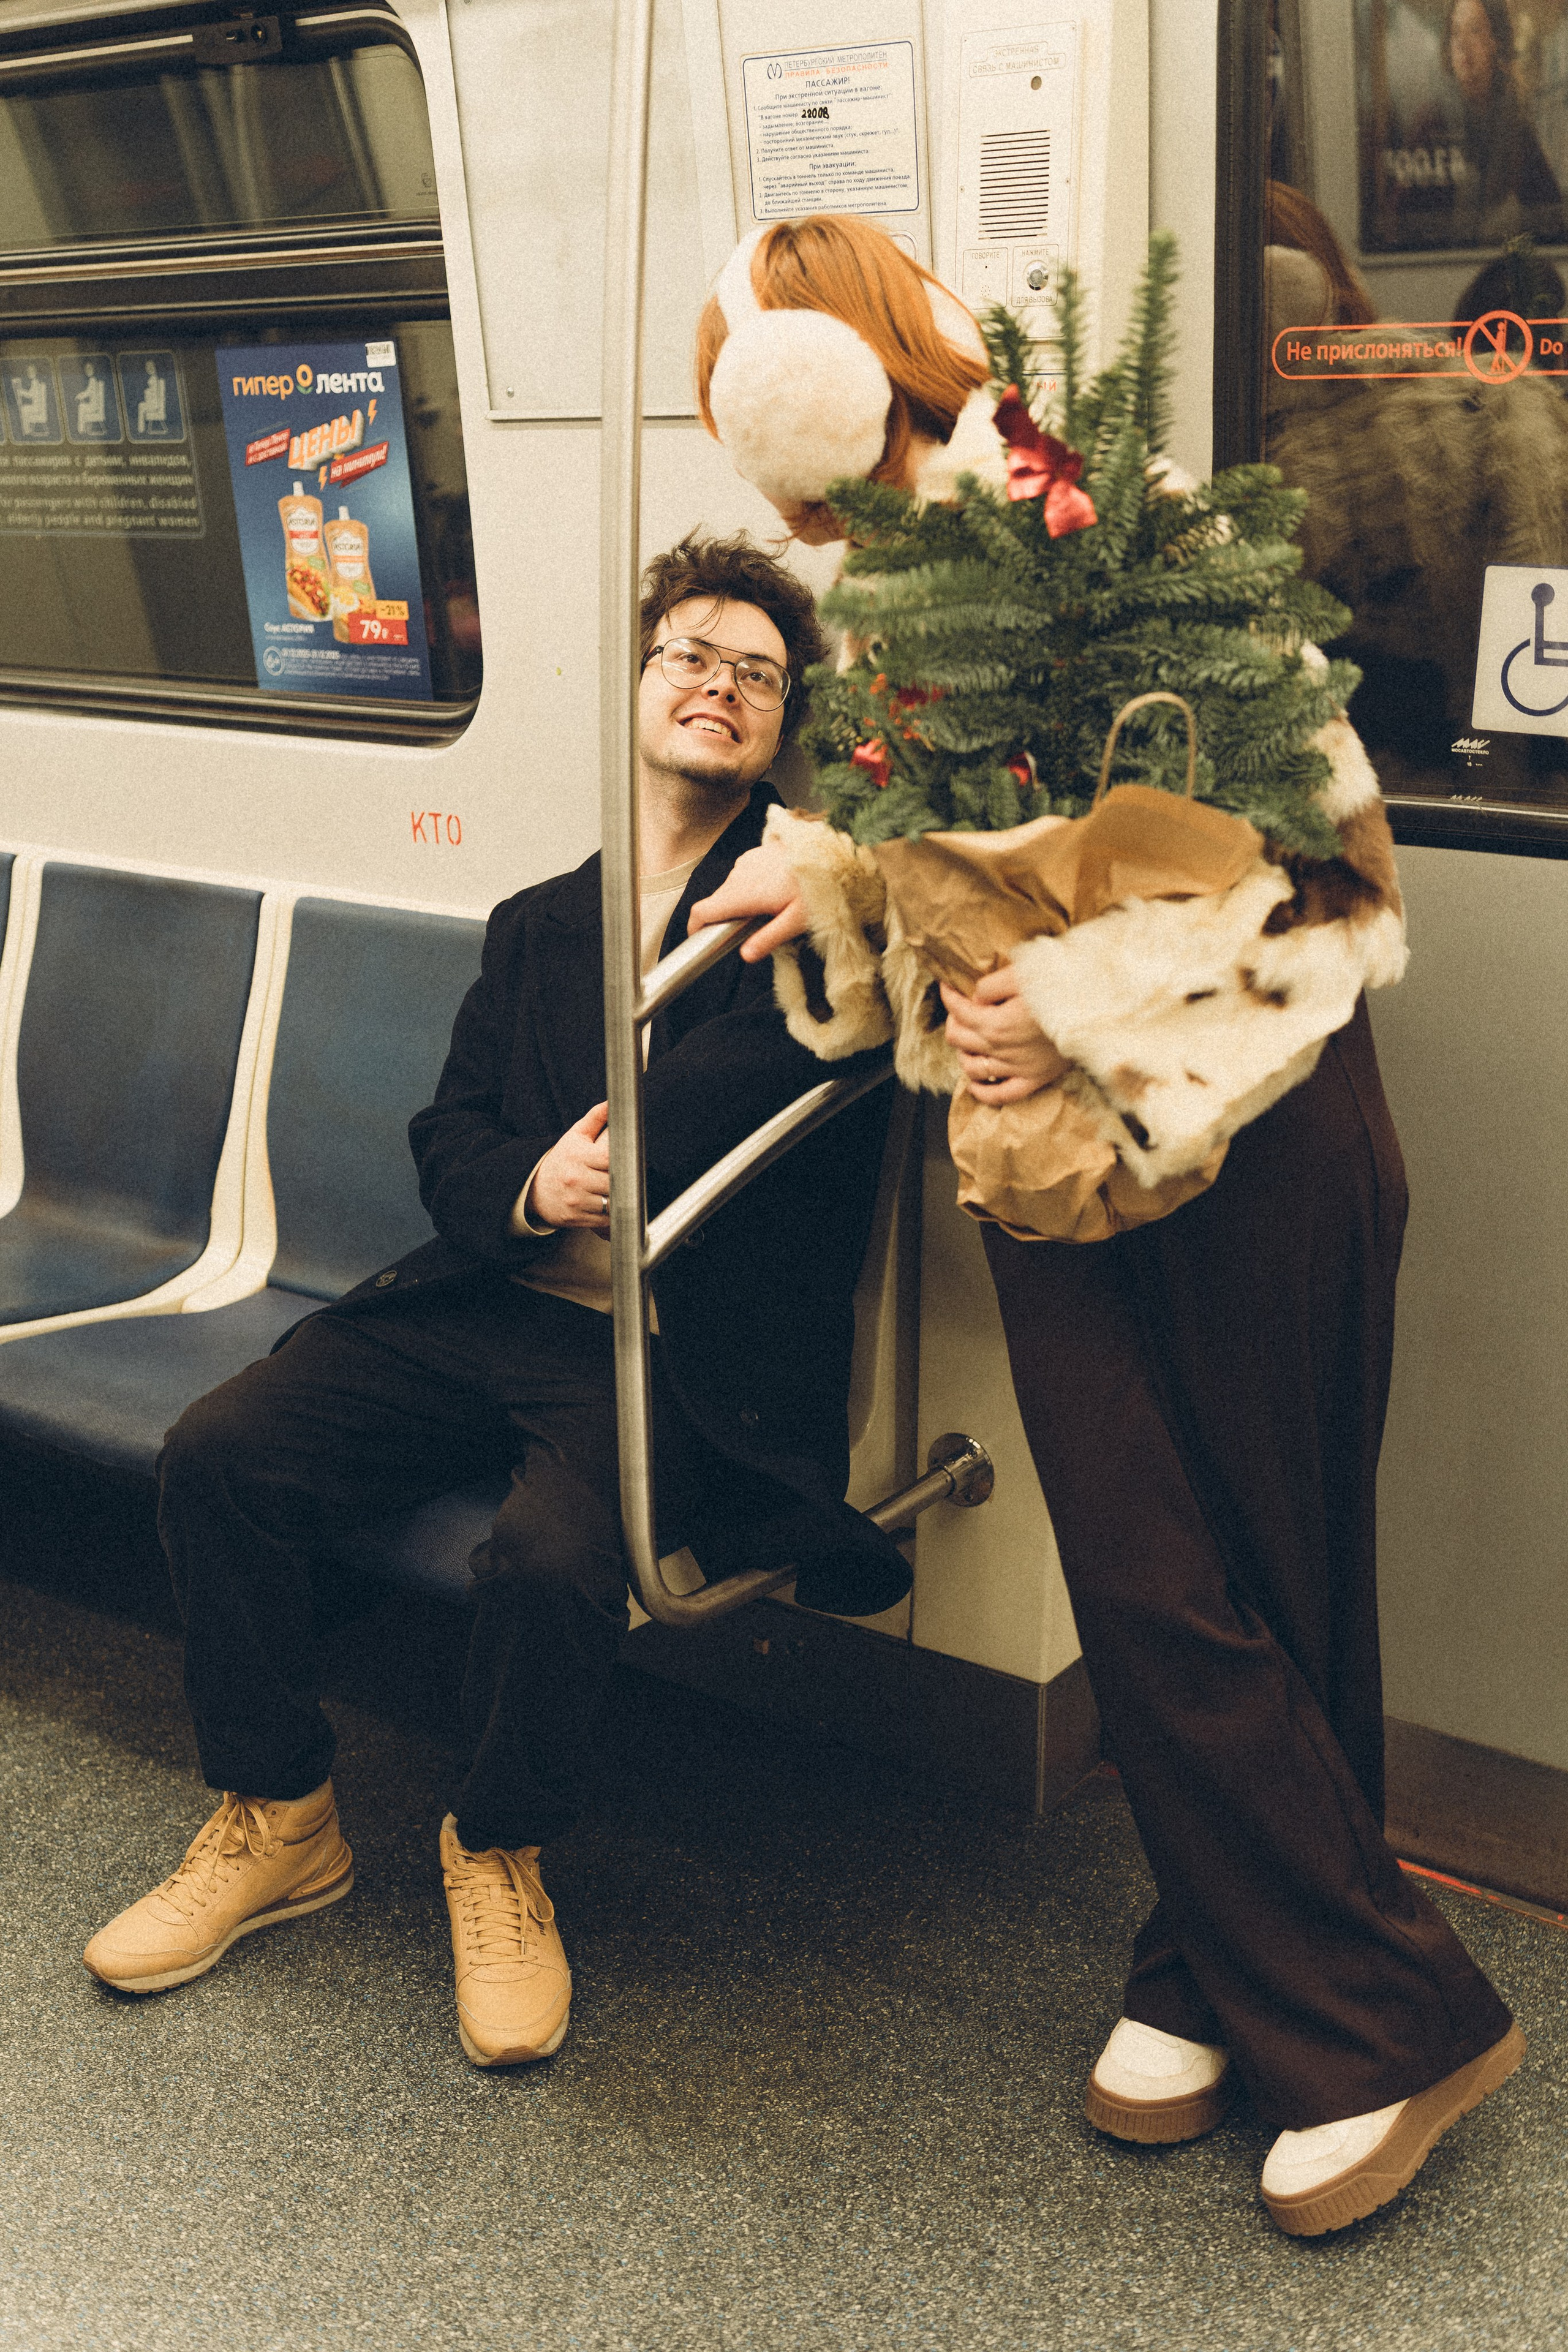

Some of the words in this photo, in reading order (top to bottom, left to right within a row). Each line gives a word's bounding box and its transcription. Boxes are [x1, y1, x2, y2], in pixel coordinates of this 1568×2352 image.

[993, 45, 1039, 57] ЭКСТРЕННАЯ
[784, 56, 834, 69] ПЕТЕРБУРГСКИЙ
[837, 51, 888, 62] МЕТРОПОЛИТЕН
[973, 64, 997, 74] СВЯЗЬ
[998, 62, 1003, 71] С
[1005, 57, 1060, 70] МАШИНИСТОМ
[785, 69, 820, 79] ПРАВИЛА
[826, 62, 888, 74] БЕЗОПАСНОСТИ
[805, 77, 851, 88] ПАССАЖИР!
[788, 90, 823, 99] экстренной
[824, 88, 853, 96] ситуации
[823, 161, 856, 170] эвакуации:
[971, 251, 1000, 260] ГОВОРИТЕ
[1021, 248, 1049, 257] НАЖМИТЕ
[1287, 341, 1311, 361] Не
[1317, 337, 1463, 366] прислоняться!
[1540, 338, 1563, 355] Do
[232, 374, 294, 401] гипер
[315, 371, 385, 394] лента
[288, 409, 364, 471] ЦЕНЫ
[410, 812, 462, 846] КТО
